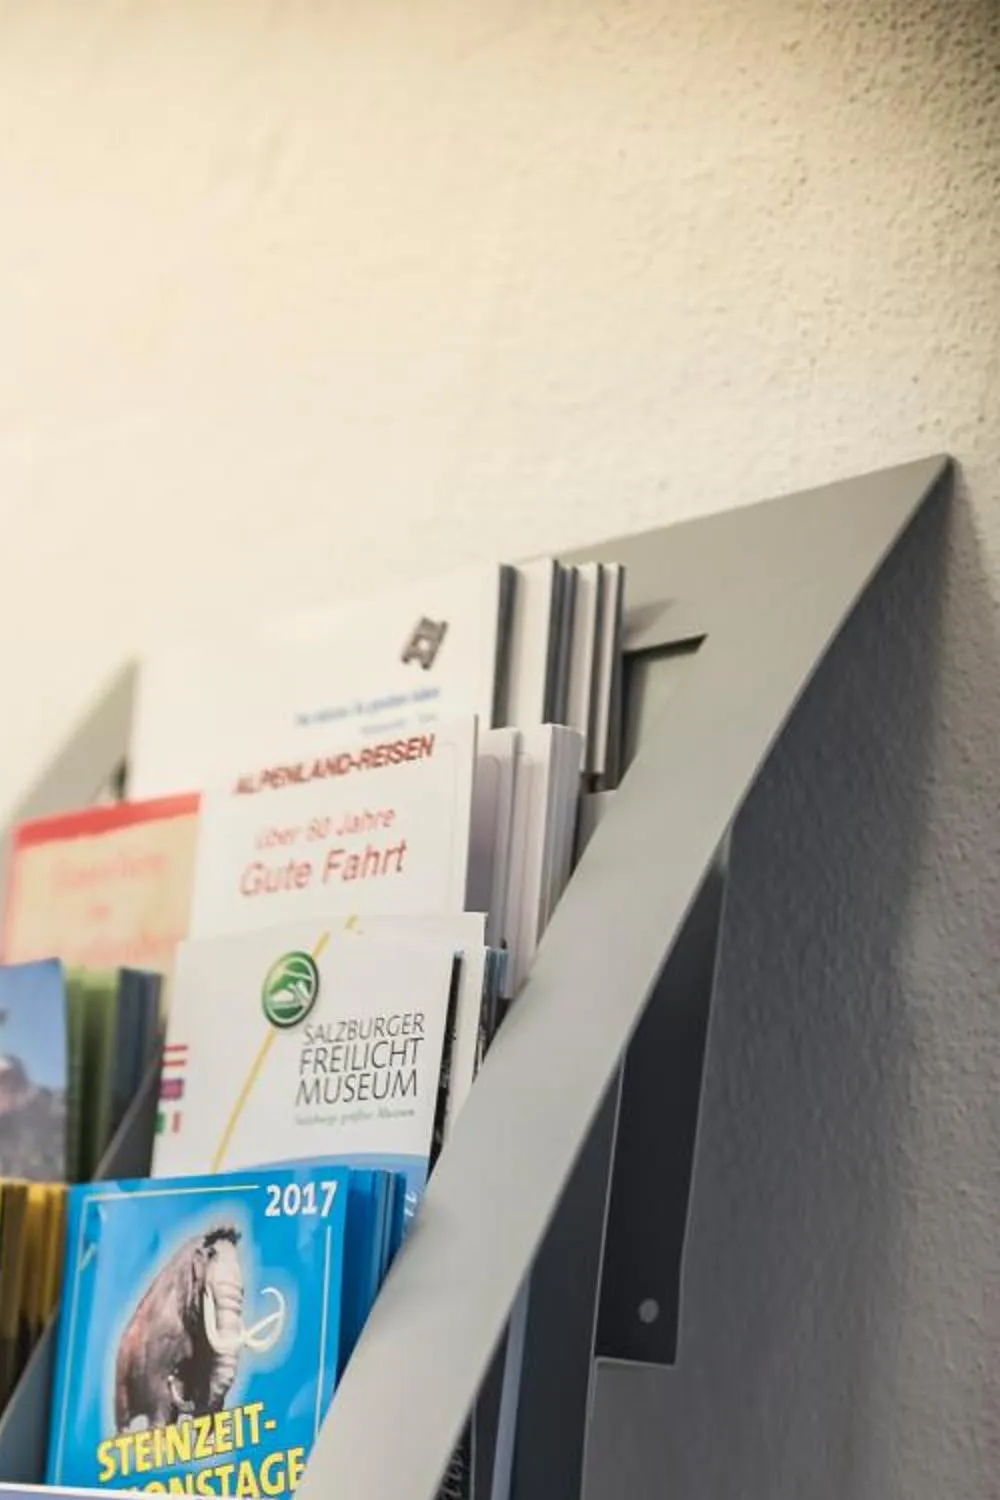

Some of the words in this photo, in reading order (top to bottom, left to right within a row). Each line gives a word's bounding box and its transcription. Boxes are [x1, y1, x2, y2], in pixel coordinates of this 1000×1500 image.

[232, 733, 436, 796] ALPENLAND-REISEN
[335, 808, 396, 837] Jahre
[238, 860, 312, 896] Gute
[322, 838, 407, 885] Fahrt
[303, 1012, 426, 1047] SALZBURGER
[299, 1036, 425, 1076] FREILICHT
[294, 1068, 418, 1108] MUSEUM
[264, 1180, 338, 1219] 2017
[96, 1402, 278, 1483] STEINZEIT-
